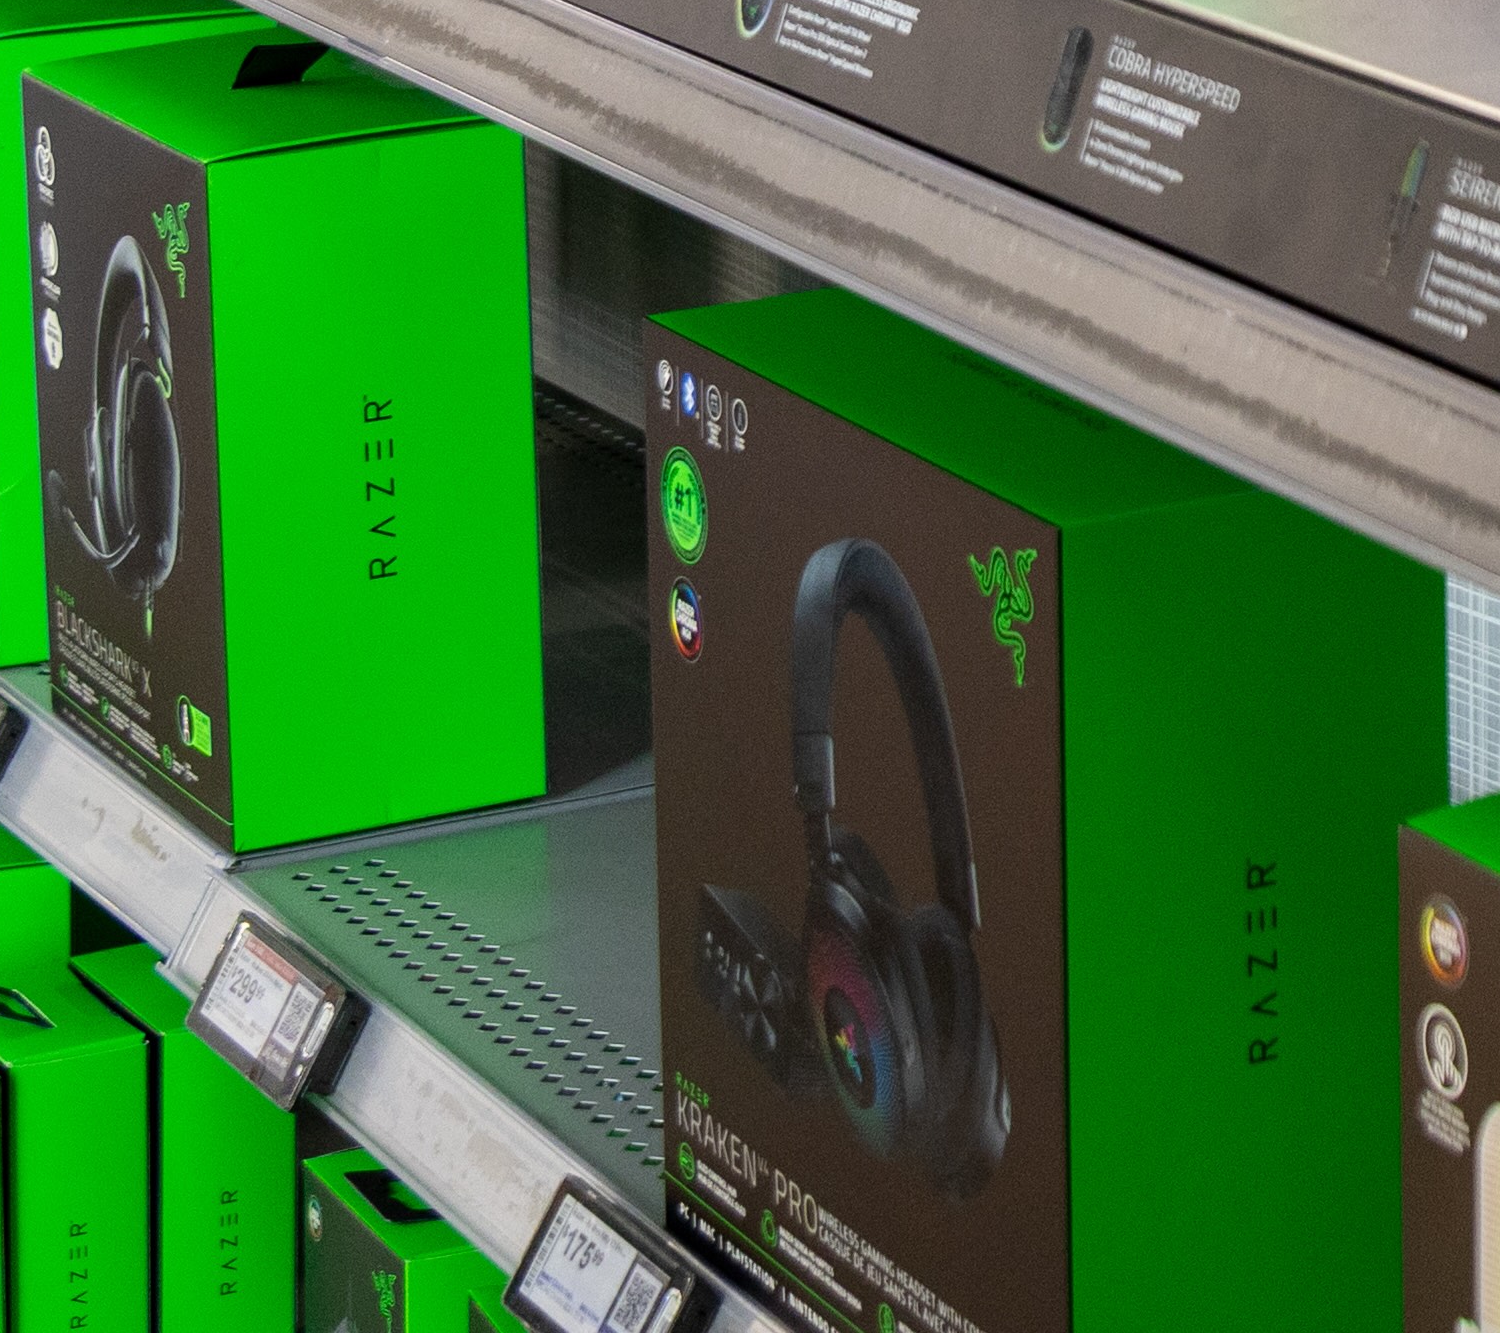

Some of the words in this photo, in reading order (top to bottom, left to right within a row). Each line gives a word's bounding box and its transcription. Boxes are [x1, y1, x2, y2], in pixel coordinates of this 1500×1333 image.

[1108, 44, 1152, 80] COBRA
[1153, 61, 1241, 113] HYPERSPEED
[363, 395, 399, 581] RAZER
[674, 482, 693, 518] #1
[55, 599, 133, 683] BLACKSHARK
[142, 665, 153, 699] X
[1246, 861, 1280, 1065] RAZER
[675, 1071, 710, 1109] RAZER
[677, 1089, 758, 1189] KRAKEN
[773, 1168, 819, 1234] PRO
[68, 1221, 89, 1330] RAZER
[220, 1189, 239, 1296] RAZER
[817, 1205, 859, 1251] WIRELESS
[860, 1237, 895, 1279] GAMING
[896, 1266, 937, 1311] HEADSET
[937, 1296, 963, 1327] WITH
[817, 1225, 852, 1265] CASQUE
[852, 1256, 865, 1273] DE
[866, 1264, 882, 1288] JEU
[883, 1278, 908, 1308] SANS
